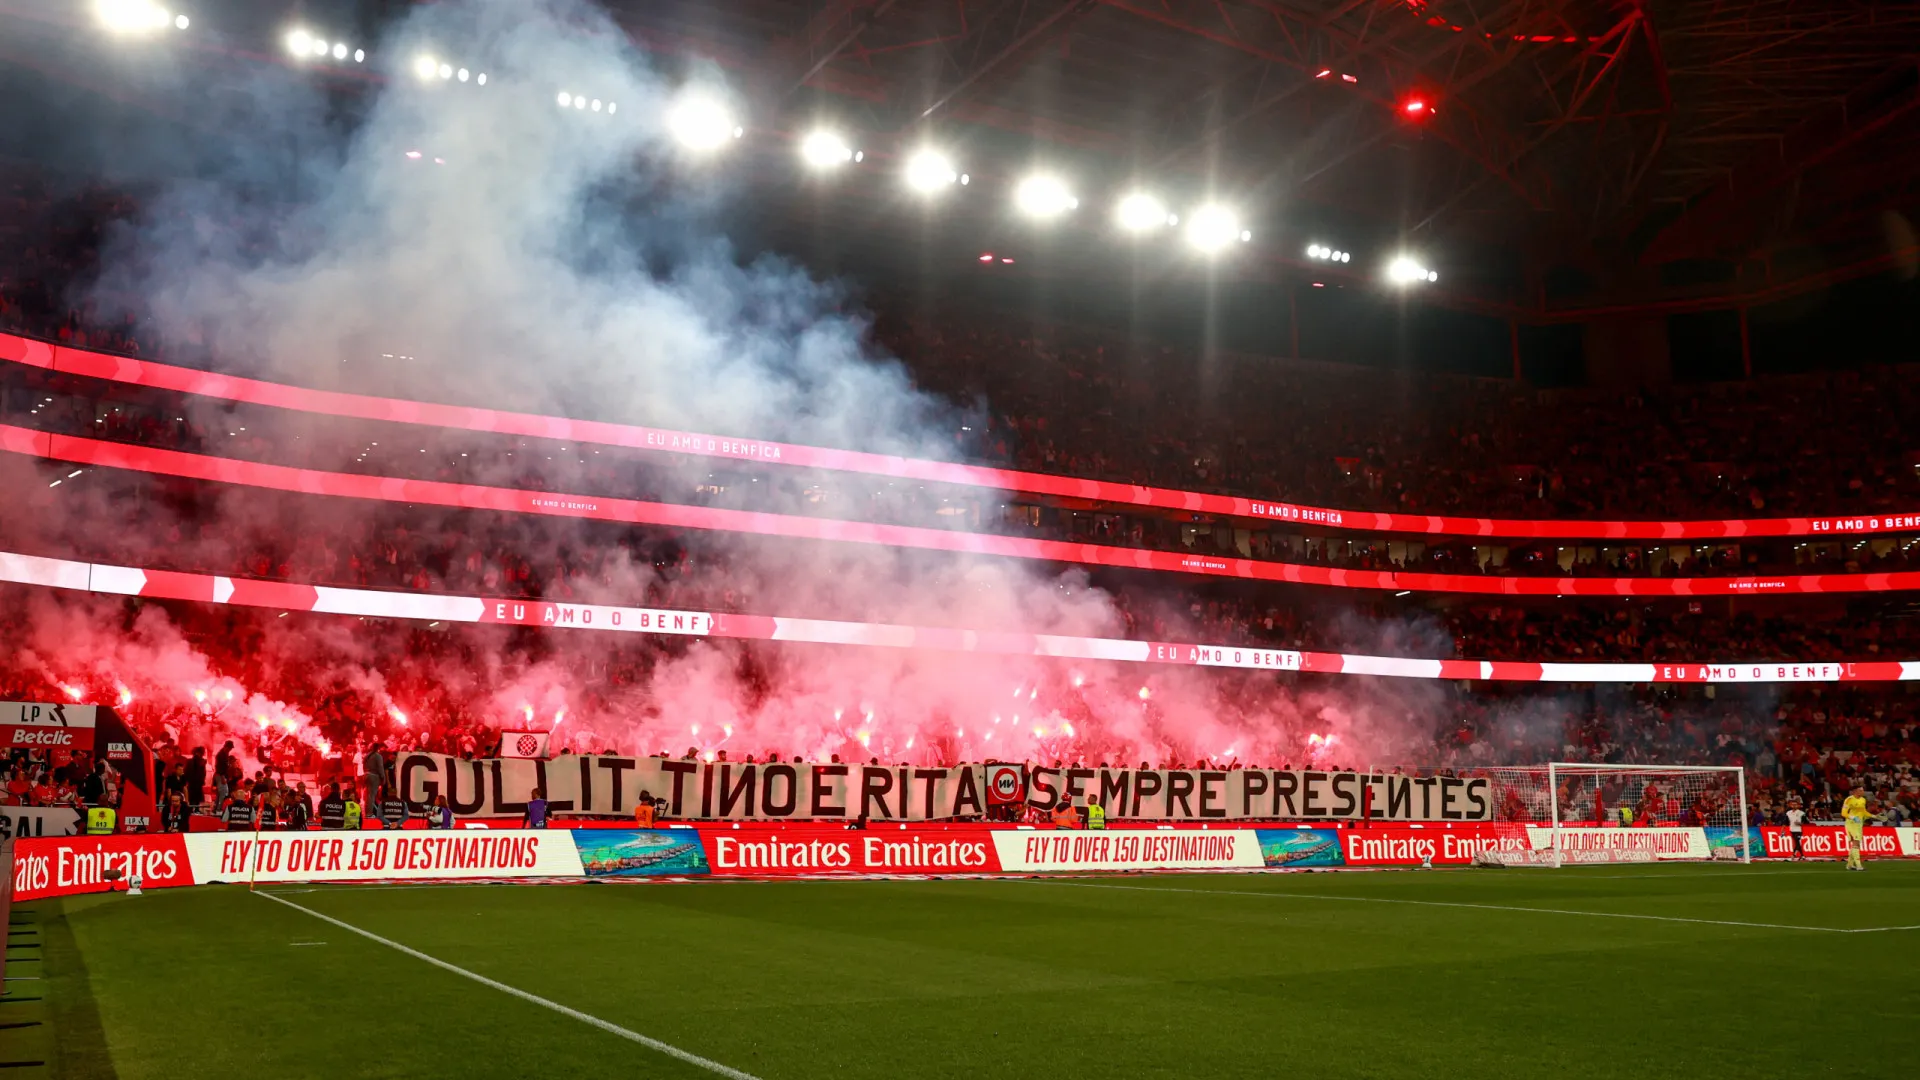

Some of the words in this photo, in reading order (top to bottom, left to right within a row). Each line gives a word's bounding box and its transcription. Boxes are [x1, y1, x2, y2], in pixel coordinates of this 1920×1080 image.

[647, 433, 665, 445] EU
[672, 436, 701, 450] AMO
[708, 440, 716, 451] O
[722, 441, 781, 458] BENFICA
[544, 500, 559, 508] AMO
[568, 503, 597, 511] BENFICA
[1252, 504, 1265, 514] EU
[1269, 506, 1289, 517] AMO
[1293, 509, 1299, 518] O
[1302, 510, 1342, 524] BENFICA
[1813, 521, 1830, 531] EU
[1836, 520, 1864, 530] AMO
[1870, 519, 1879, 529] O
[496, 603, 525, 621] EU
[544, 606, 592, 624] AMO
[611, 611, 621, 626] O
[1158, 646, 1177, 660] EU
[1189, 648, 1222, 662] AMO
[1235, 652, 1241, 663] O
[1664, 667, 1685, 679] EU
[1699, 667, 1736, 679] AMO
[1753, 667, 1761, 678] O
[21, 705, 40, 722] LP
[13, 729, 73, 745] Betclic
[400, 755, 635, 814] GULLIT
[811, 766, 848, 816] E
[861, 766, 981, 818] RITA
[1028, 765, 1226, 818] SEMPRE
[716, 836, 851, 868] Emirates
[863, 836, 986, 868] Emirates
[1025, 837, 1050, 864] FLY
[1052, 837, 1071, 863] TO
[1073, 836, 1108, 863] OVER
[1110, 836, 1138, 863] 150
[1143, 835, 1235, 862] DESTINATIONS
[1348, 834, 1435, 864] Emirates
[1443, 833, 1525, 860] Emirates
[1582, 833, 1604, 850] OVER
[1608, 833, 1625, 850] 150
[1628, 833, 1689, 853] DESTINATIONS
[1767, 831, 1831, 852] Emates
[57, 843, 177, 887] Emirates
[221, 840, 252, 874] FLY
[256, 839, 282, 872] TO
[287, 839, 343, 872] OVER
[348, 838, 388, 871] 150
[393, 836, 539, 870] DESTINATIONS
[16, 852, 49, 892] ates
